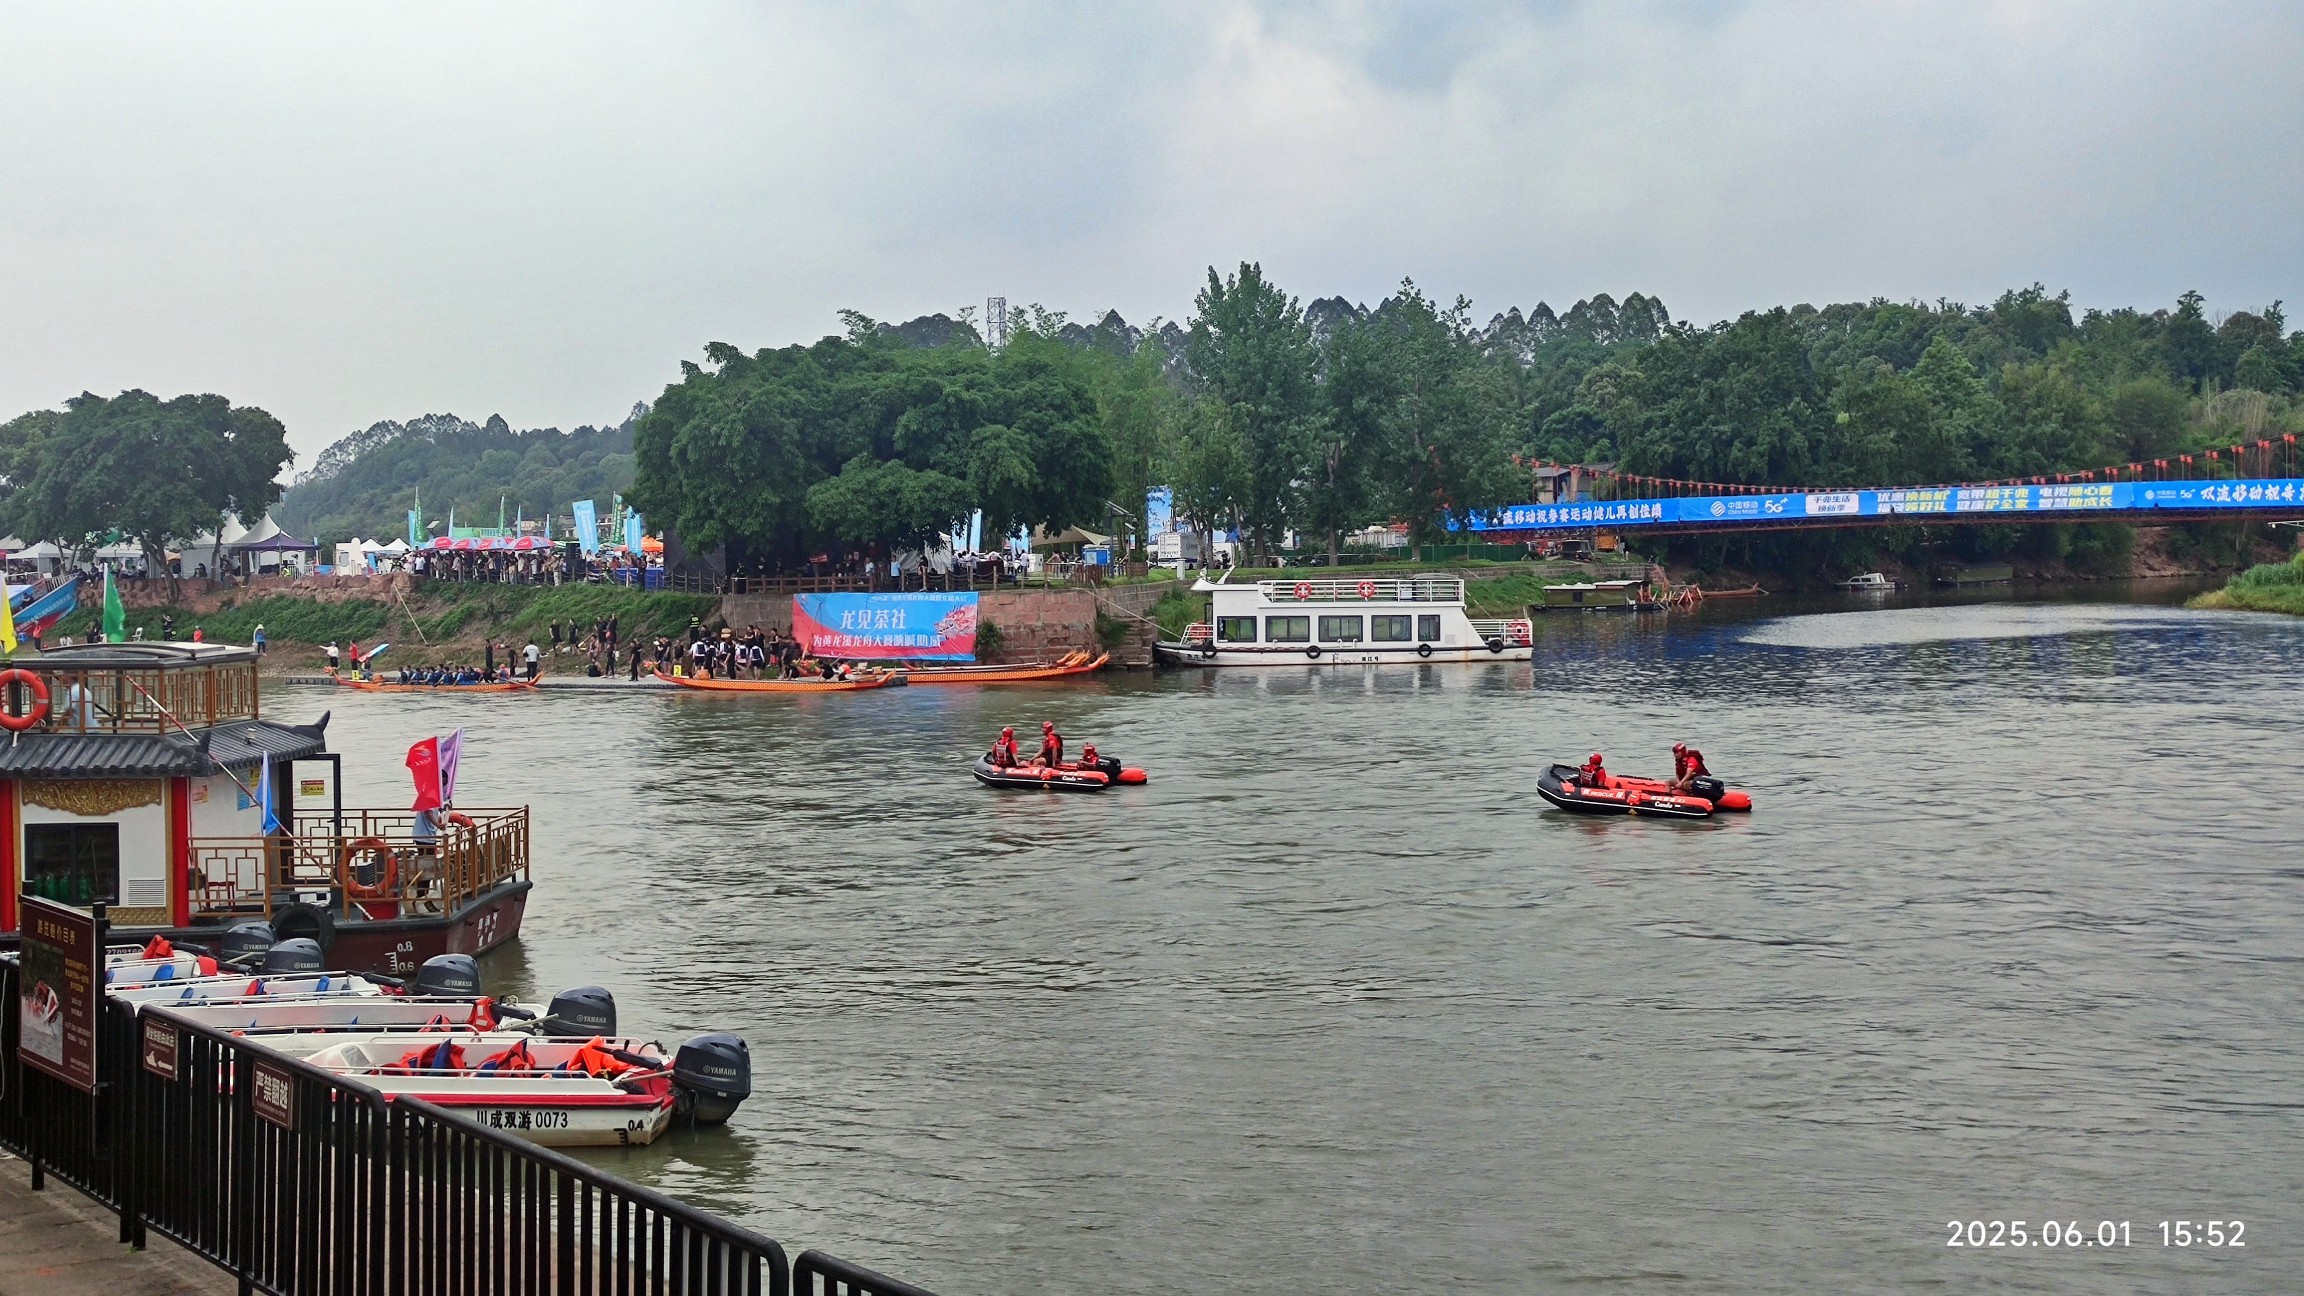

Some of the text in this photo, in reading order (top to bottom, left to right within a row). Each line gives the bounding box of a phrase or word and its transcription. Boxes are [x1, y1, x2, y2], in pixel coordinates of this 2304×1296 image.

[1957, 488, 2028, 499] 宽带超千兆
[2039, 485, 2113, 497] 电视随心看
[2200, 482, 2304, 503] 双流移动祝黄
[1728, 501, 1758, 509] 中国移动
[2039, 496, 2113, 508] 智慧助成长
[1494, 502, 1663, 525] 流移动祝参赛运动健儿再创佳绩
[840, 608, 907, 630] 龙见茶社
[813, 634, 942, 648] 为黄龙溪龙舟大赛呐喊助威
[397, 941, 413, 952] 0.8
[399, 961, 414, 971] 0.6
[584, 1015, 607, 1024] YAMAHA
[711, 1066, 737, 1076] YAMAHA
[255, 1070, 288, 1110] 严禁翻越
[476, 1110, 568, 1131] 川成双游 0073
[628, 1119, 644, 1132] 0.4
